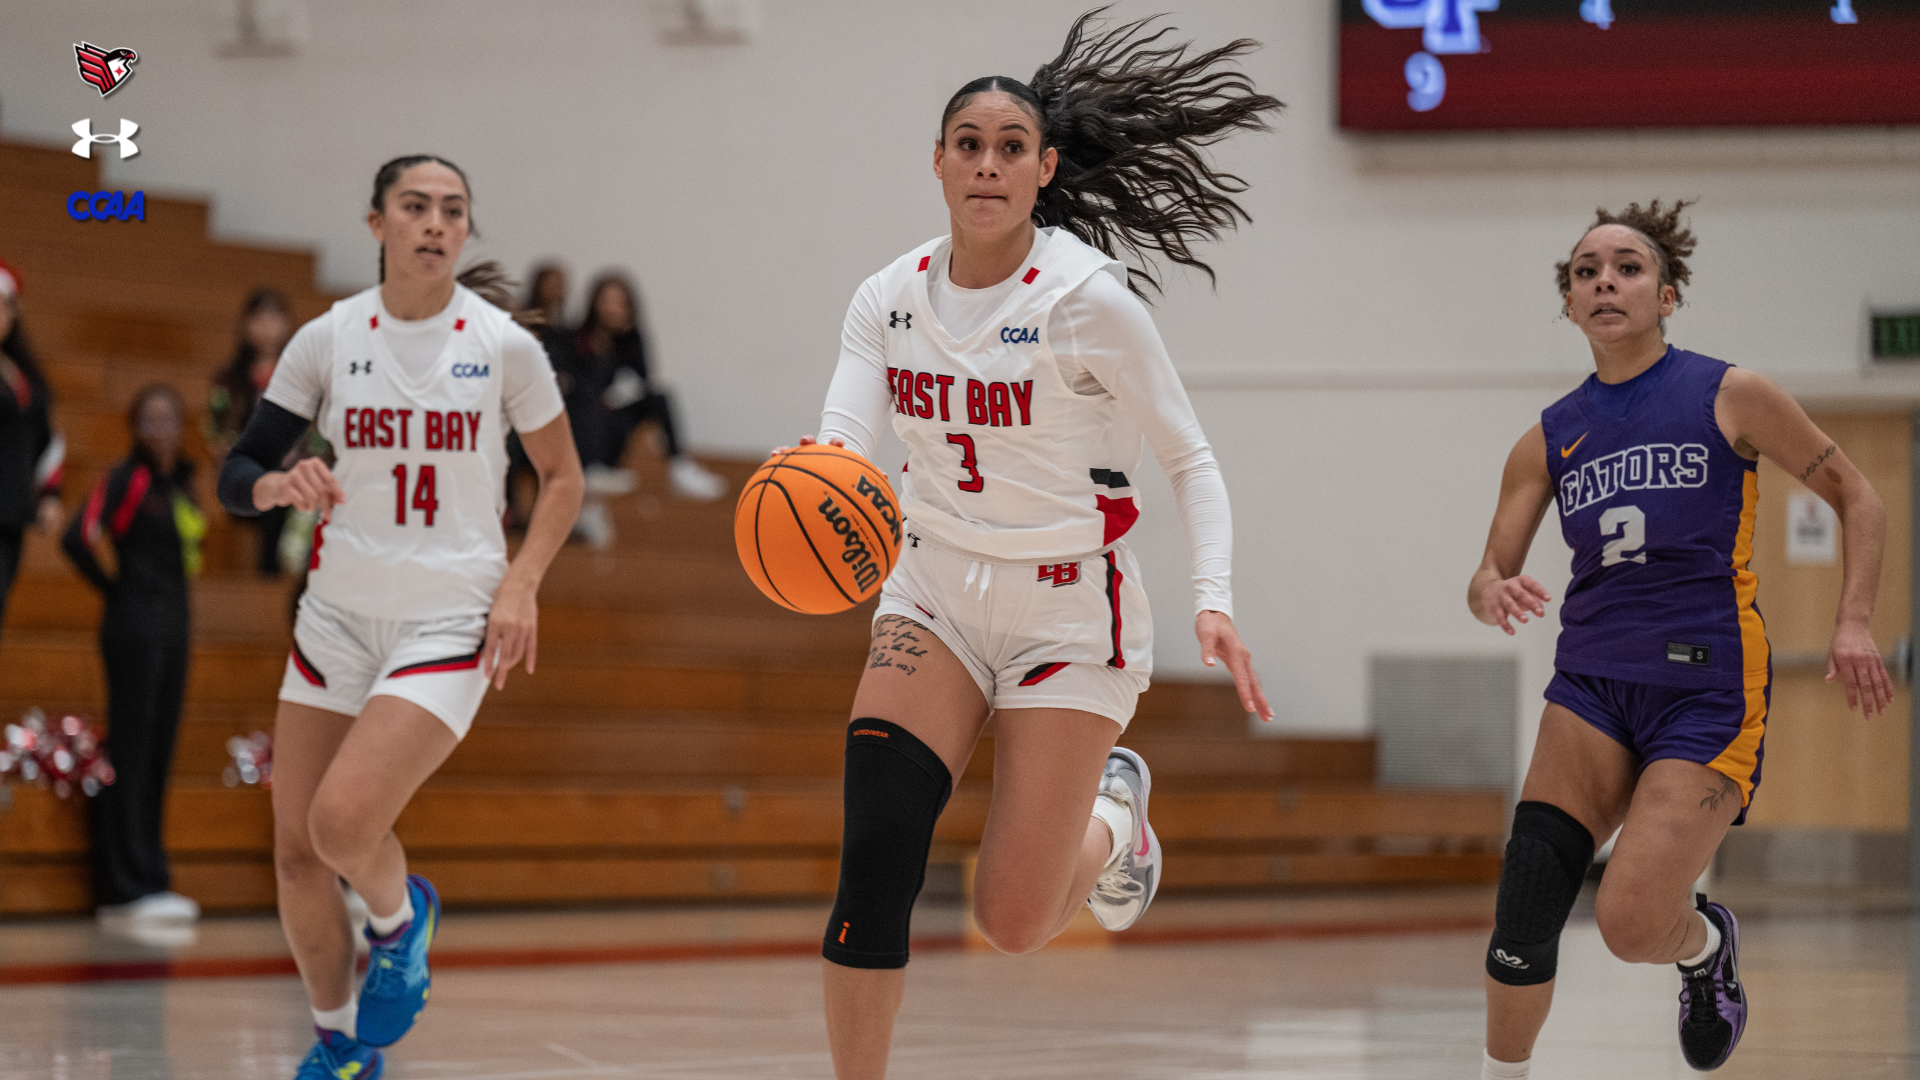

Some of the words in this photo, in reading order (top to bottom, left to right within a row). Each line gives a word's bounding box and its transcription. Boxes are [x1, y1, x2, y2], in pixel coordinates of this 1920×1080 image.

[1404, 51, 1447, 112] 9
[1000, 326, 1040, 344] CCAA
[451, 363, 490, 378] CCAA
[344, 408, 414, 449] EAST
[424, 410, 482, 452] BAY
[966, 378, 1034, 428] BAY
[945, 432, 985, 493] 3
[1560, 443, 1710, 517] GATORS
[391, 463, 440, 527] 14
[855, 473, 902, 547] NCAA
[817, 495, 881, 594] Wilson
[1598, 505, 1648, 568] 2
[1696, 650, 1704, 660] S
